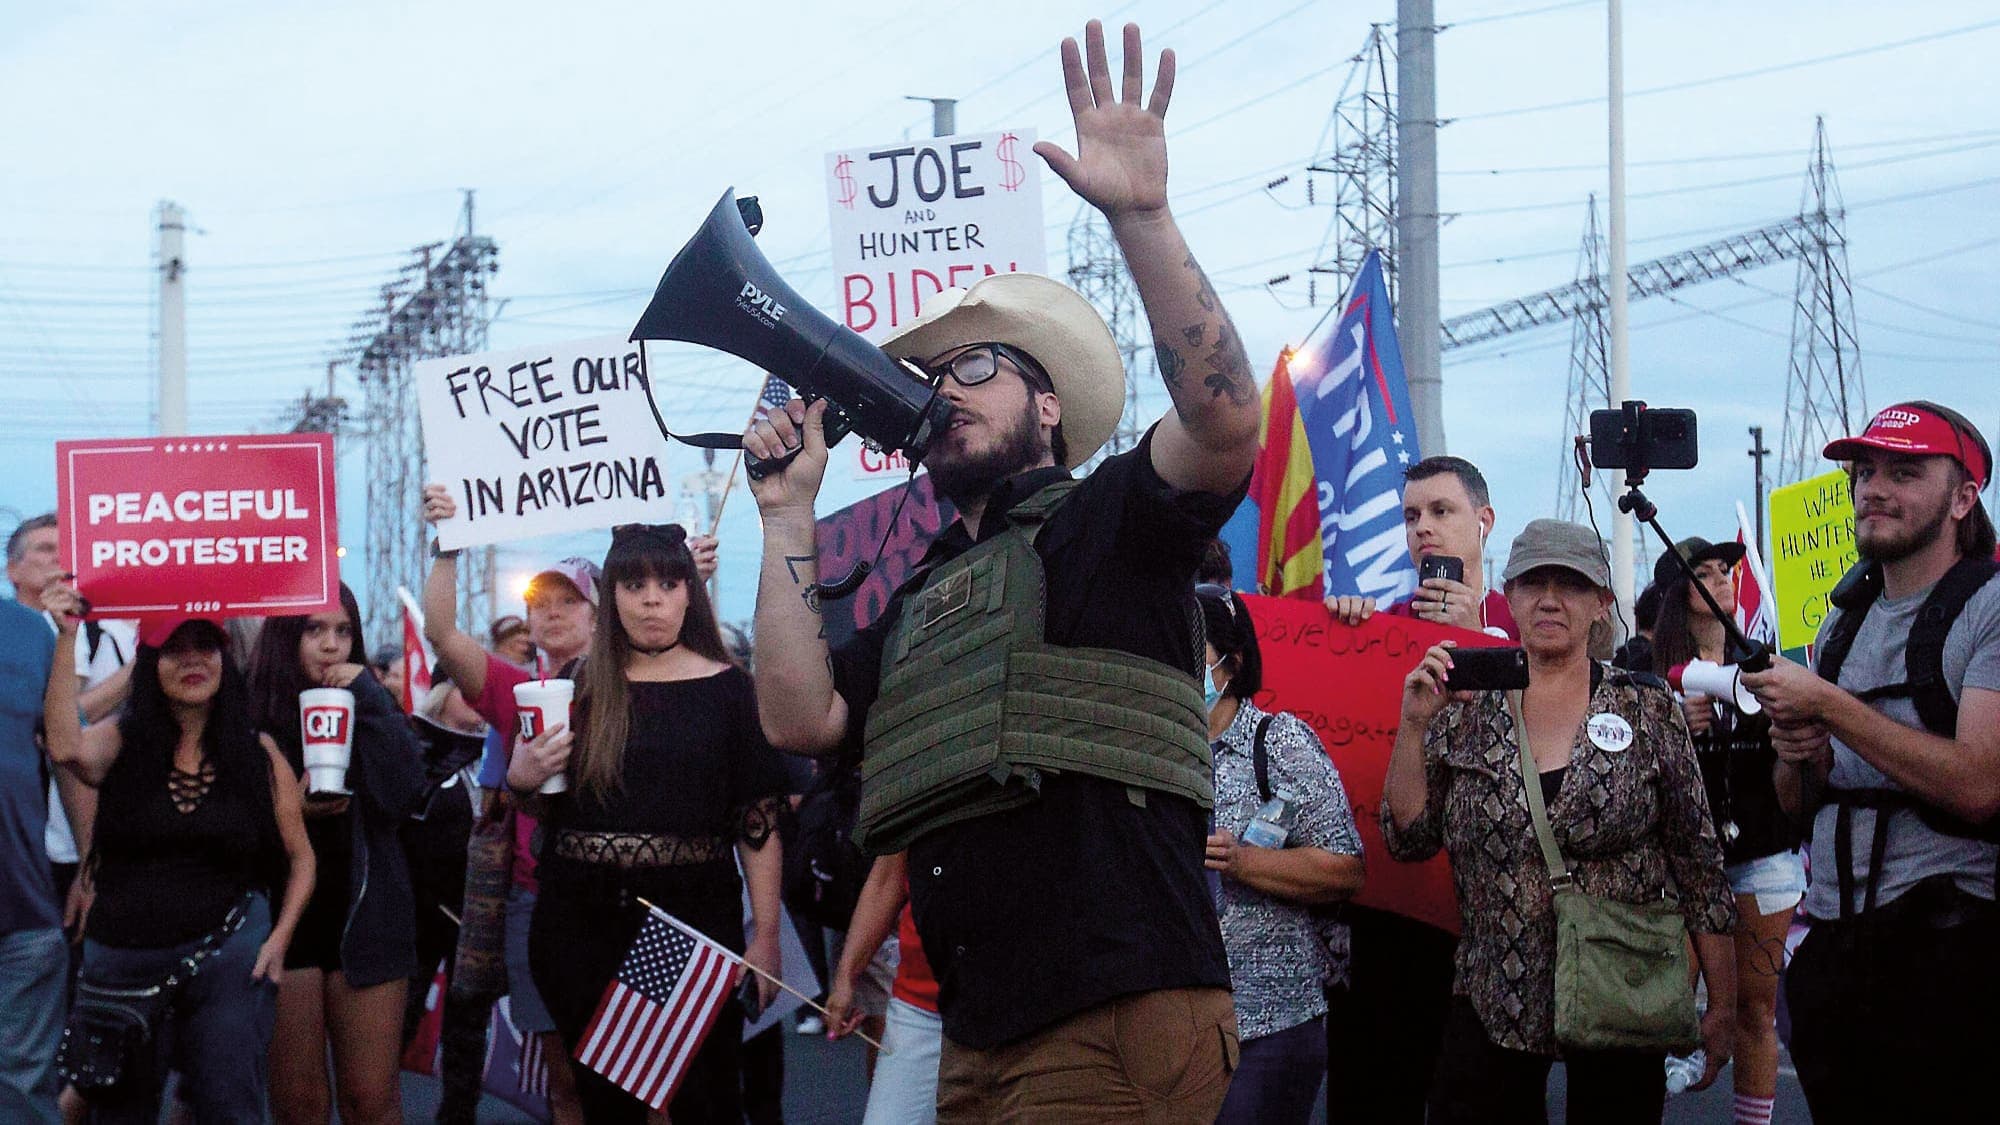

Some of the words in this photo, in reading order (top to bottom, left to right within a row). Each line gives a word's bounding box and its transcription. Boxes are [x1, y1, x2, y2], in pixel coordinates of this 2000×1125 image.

[867, 141, 985, 208] JOE
[904, 208, 936, 224] AND
[859, 223, 985, 260] HUNTER
[740, 281, 788, 320] PYLE
[446, 357, 562, 418] FREE
[573, 352, 648, 395] OUR
[500, 404, 608, 459] VOTE
[1316, 320, 1418, 613] TRUM
[88, 489, 309, 525] PEACEFUL
[462, 477, 504, 521] IN
[516, 456, 665, 516] ARIZONA
[91, 535, 309, 568] PROTESTER
[1810, 560, 1833, 581] HE
[184, 601, 221, 613] 2020
[306, 709, 343, 738] QT
